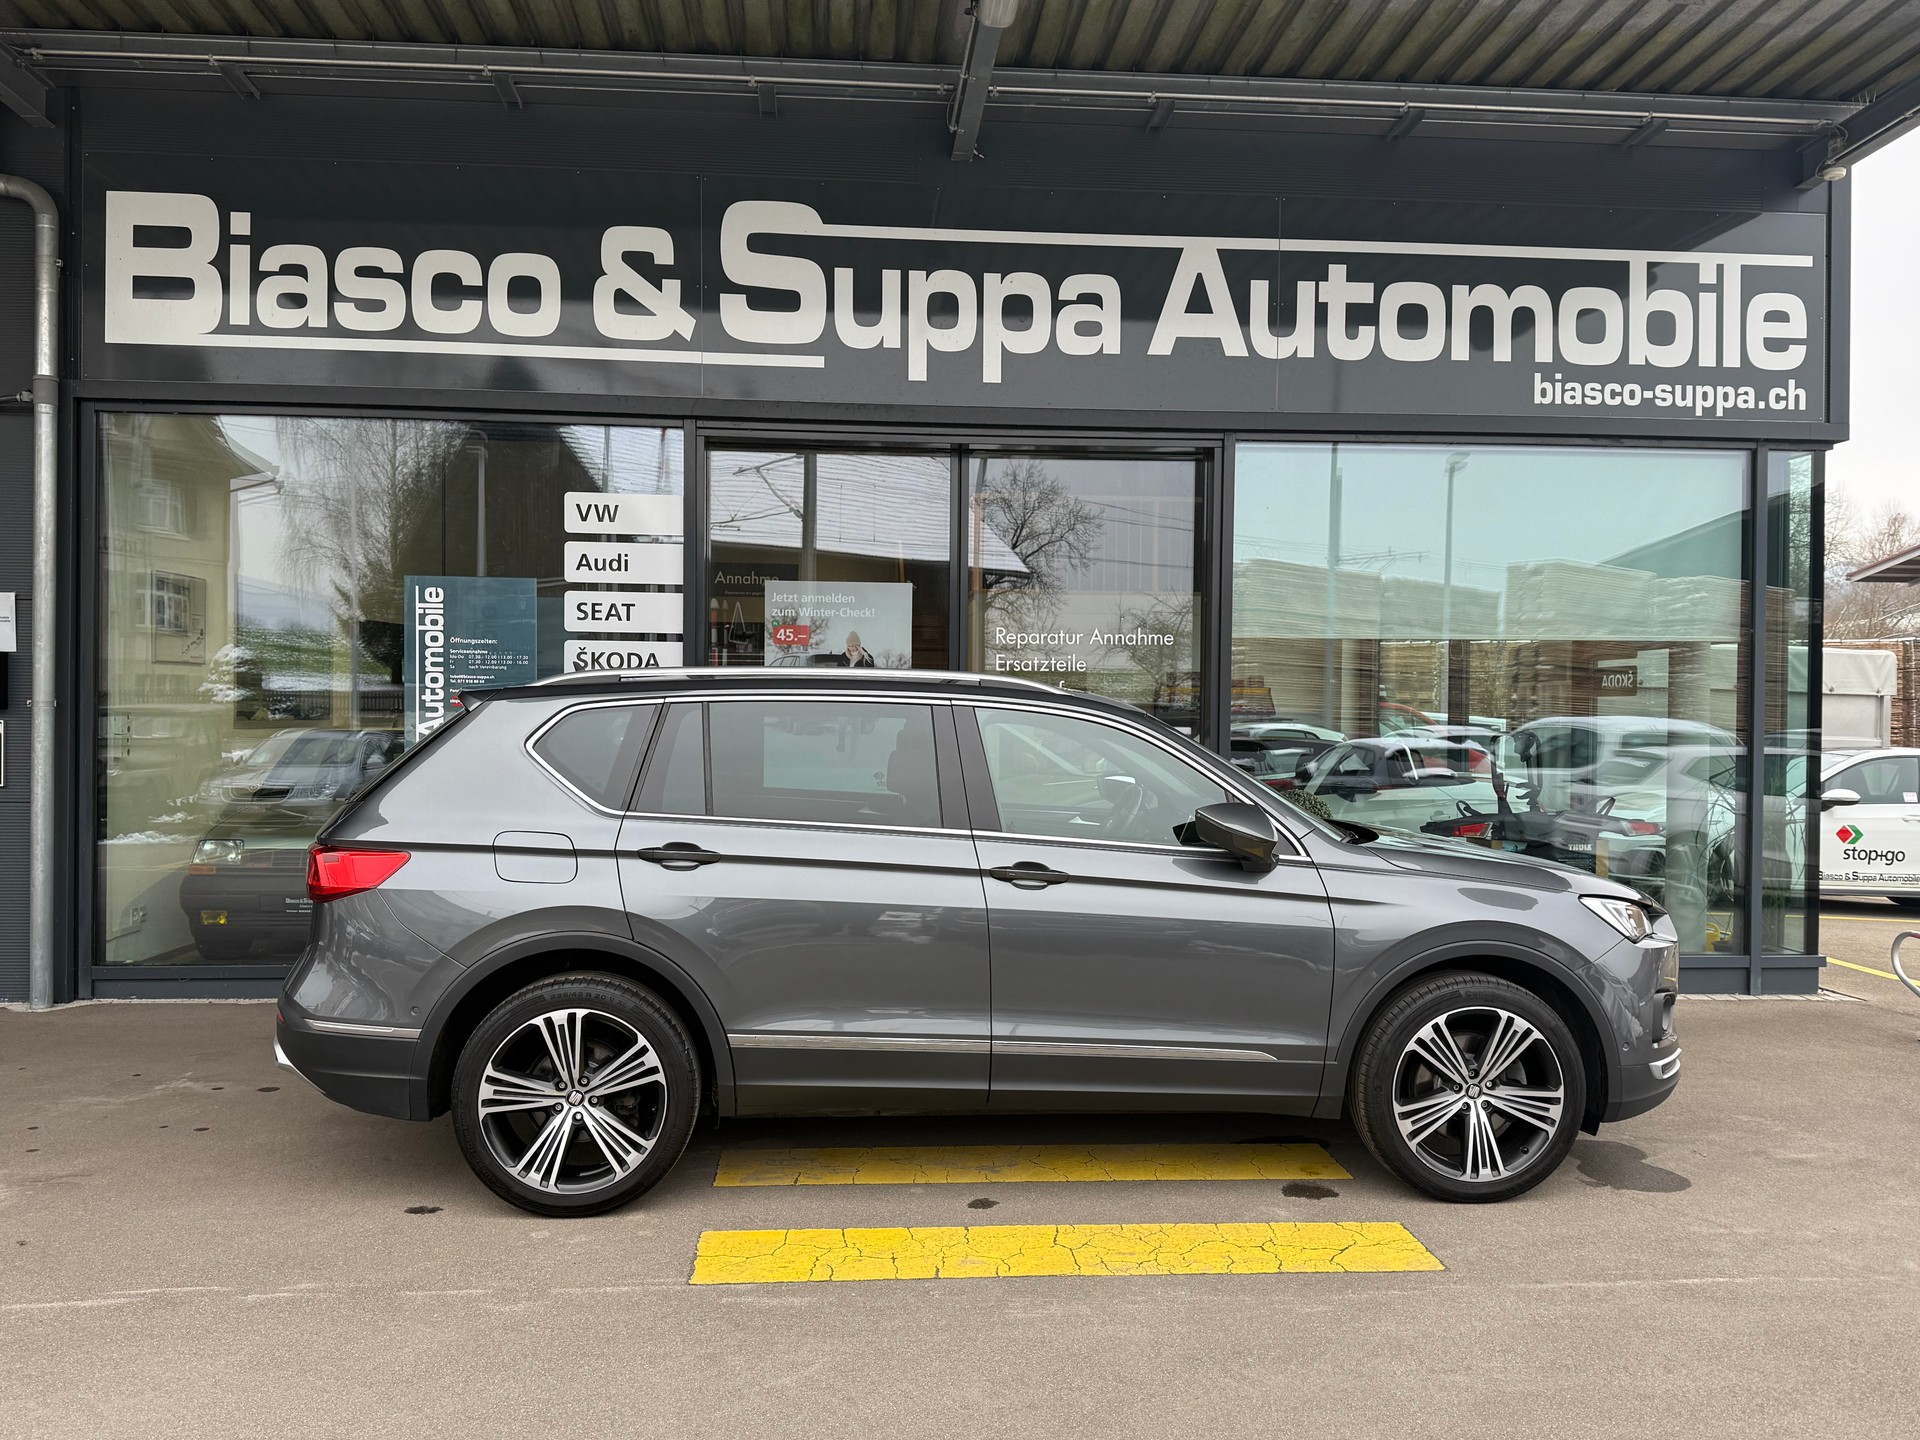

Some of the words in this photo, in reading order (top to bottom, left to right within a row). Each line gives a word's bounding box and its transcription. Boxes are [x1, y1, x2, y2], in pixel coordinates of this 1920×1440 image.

[105, 191, 562, 344] Biasco
[592, 226, 697, 342] &
[721, 200, 1121, 383] Suppa
[1147, 239, 1808, 370] Automobile
[1533, 373, 1807, 417] biasco-suppa.ch
[576, 504, 619, 522] VW
[576, 554, 629, 572] Audi
[772, 593, 798, 603] Jetzt
[801, 593, 855, 603] anmelden
[576, 602, 636, 622] SEAT
[772, 609, 795, 617] zum
[798, 607, 876, 618] Winter-Check!
[995, 626, 1084, 649] Reparatur
[1089, 627, 1174, 646] Annahme
[418, 587, 445, 736] Automobile
[576, 647, 660, 671] ŠKODA
[995, 653, 1087, 672] Ersatzteile
[1843, 846, 1906, 866] stop+go
[1845, 872, 1851, 881] &
[1852, 871, 1877, 883] Suppa
[1878, 873, 1920, 882] Automobile
[594, 993, 607, 1001] 20
